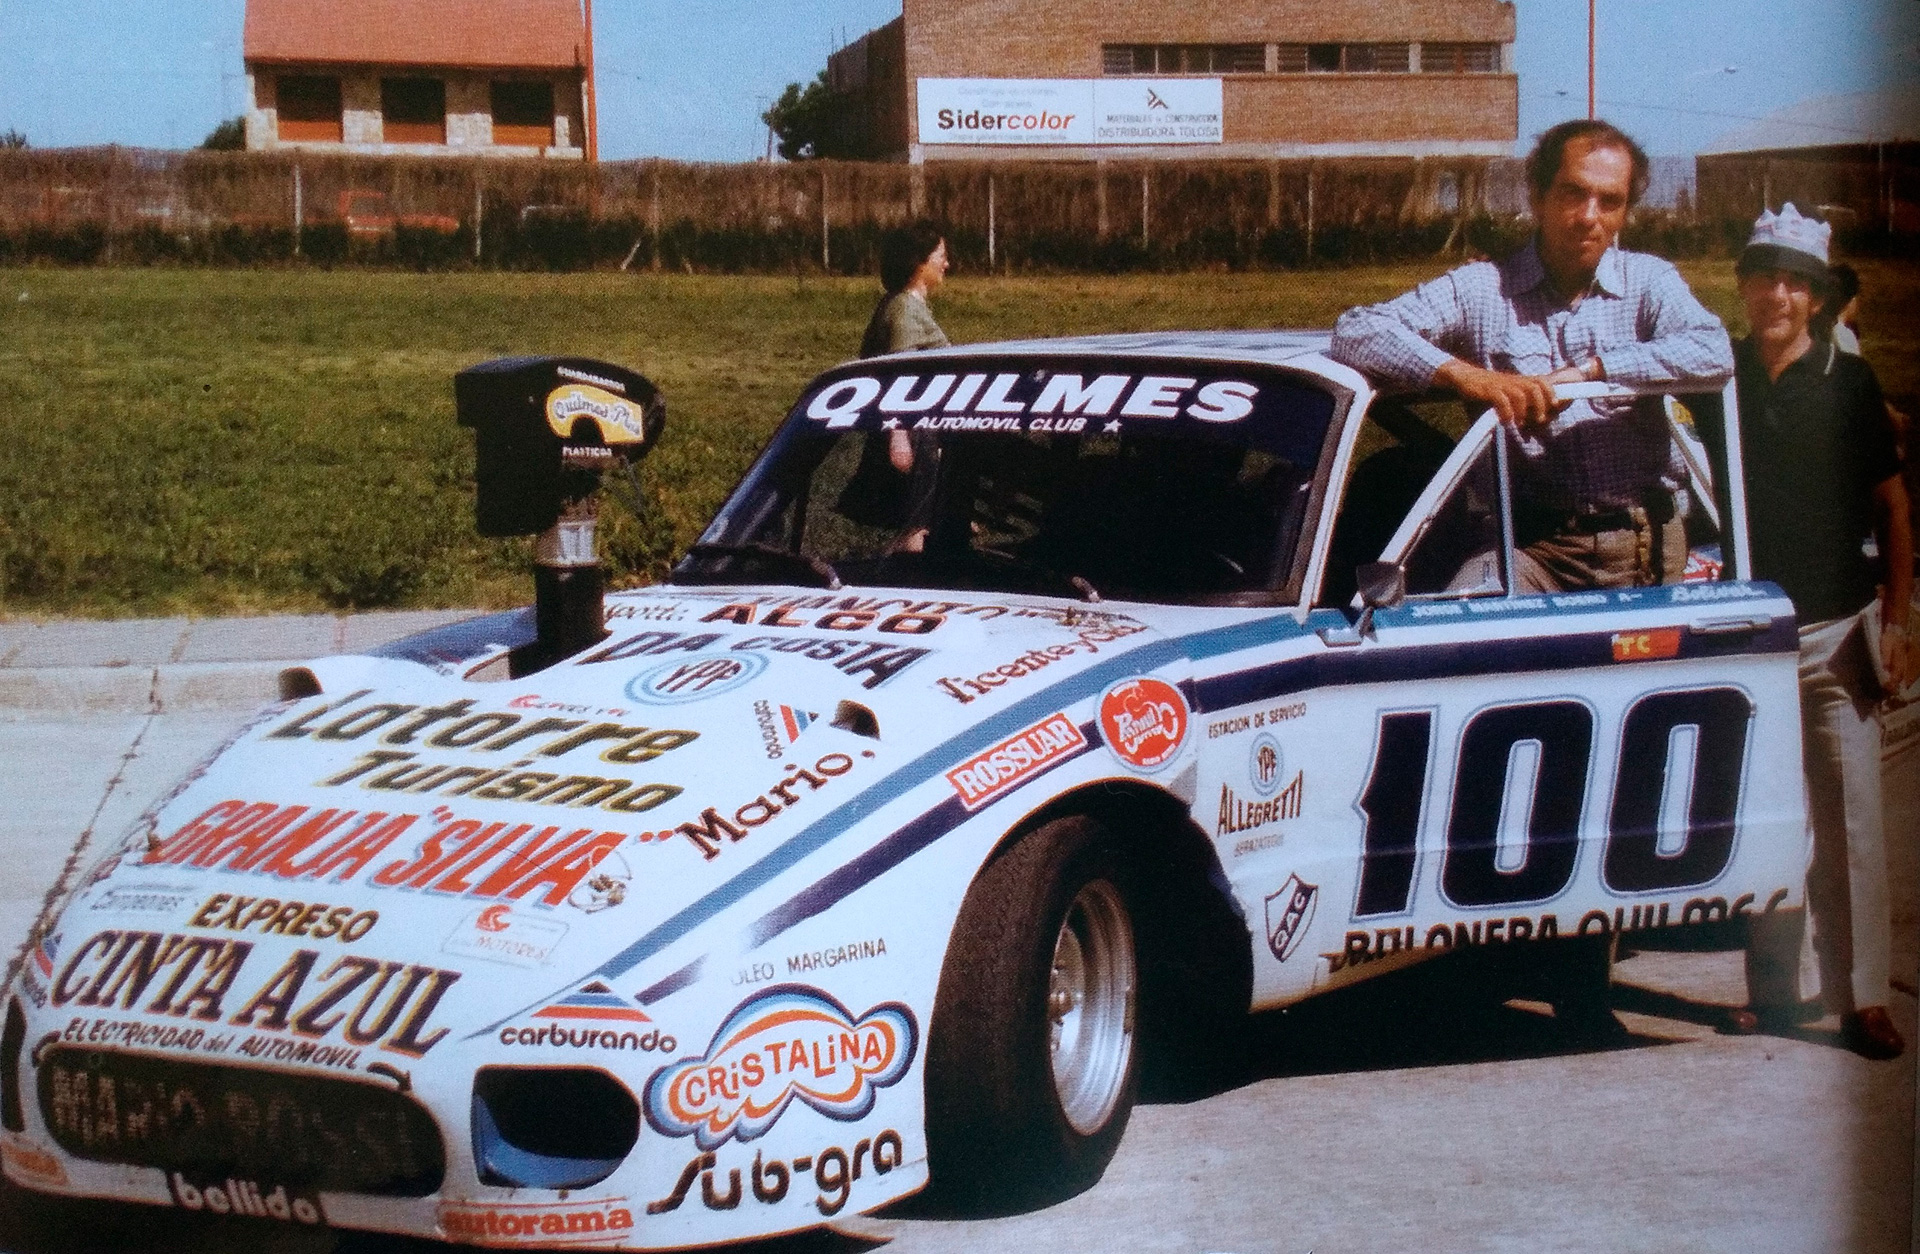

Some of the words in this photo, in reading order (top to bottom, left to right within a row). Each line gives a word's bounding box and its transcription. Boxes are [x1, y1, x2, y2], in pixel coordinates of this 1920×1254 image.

[937, 108, 1075, 130] Sidercolor
[806, 373, 1260, 428] QUILMES
[913, 416, 1021, 431] AUTOMOVIL
[1029, 417, 1086, 433] CLUB
[698, 604, 944, 634] ALGO
[1618, 634, 1651, 655] TC
[655, 659, 743, 693] YPF
[266, 689, 700, 764] Latorre
[1208, 718, 1251, 739] ESTACION
[1254, 711, 1267, 727] DE
[1269, 702, 1308, 723] SERVICIO
[313, 750, 686, 813] Turismo
[953, 717, 1080, 800] ROSSUAR
[1257, 746, 1277, 783] YPF
[1216, 769, 1304, 838] ALLEGRETTI
[1349, 682, 1756, 923] 100
[140, 800, 419, 881] GRANJA
[187, 894, 380, 943] EXPRESO
[786, 938, 887, 974] MARGARINA
[51, 930, 253, 1022] CINTA
[229, 949, 462, 1058] AZUL
[64, 1019, 203, 1049] ELECTRICIDAD
[204, 1035, 231, 1053] del
[239, 1039, 360, 1069] AUTOMOVIL
[499, 1022, 677, 1053] carburando
[173, 1174, 320, 1224] bellido
[443, 1209, 633, 1235] autorama
